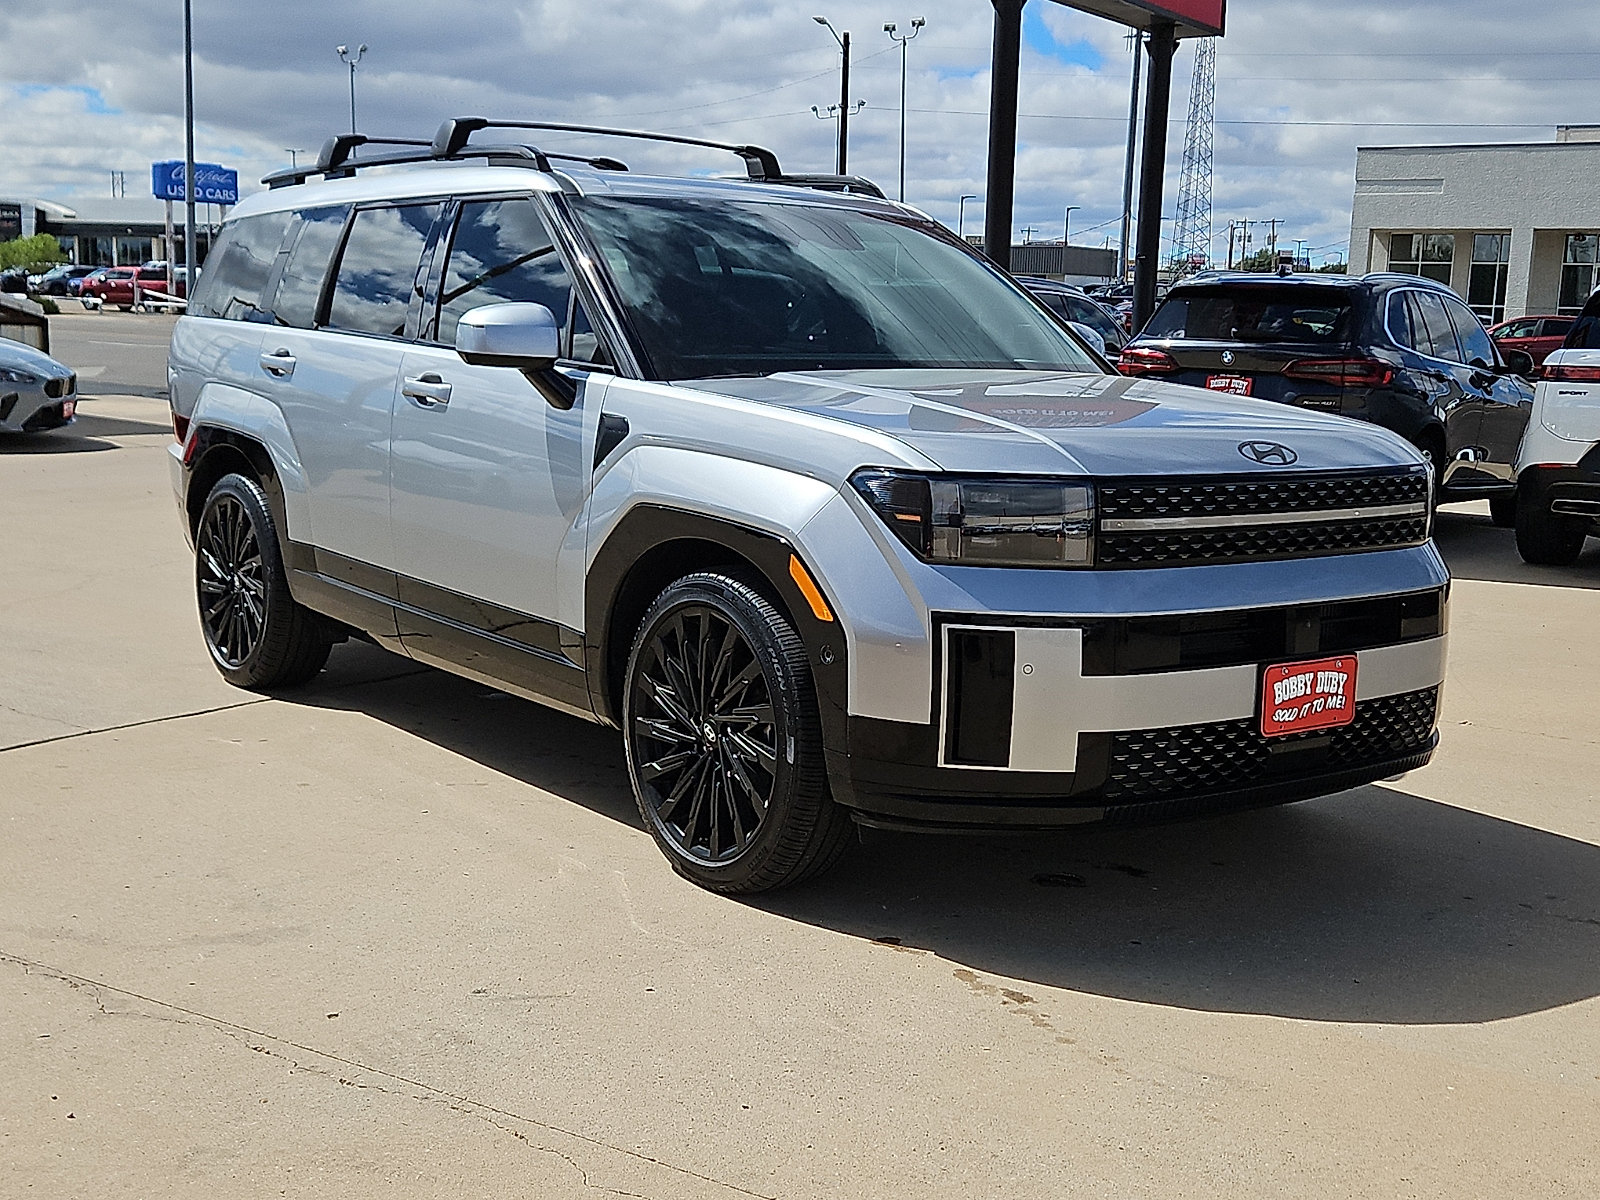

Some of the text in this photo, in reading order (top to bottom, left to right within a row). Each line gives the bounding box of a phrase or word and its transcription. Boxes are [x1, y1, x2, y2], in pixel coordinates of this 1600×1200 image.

[171, 165, 233, 185] Cetified
[167, 184, 236, 200] USD CARS
[1274, 671, 1348, 705] BOBBY DUBY
[1272, 695, 1346, 721] SOLD IT TO ME!
